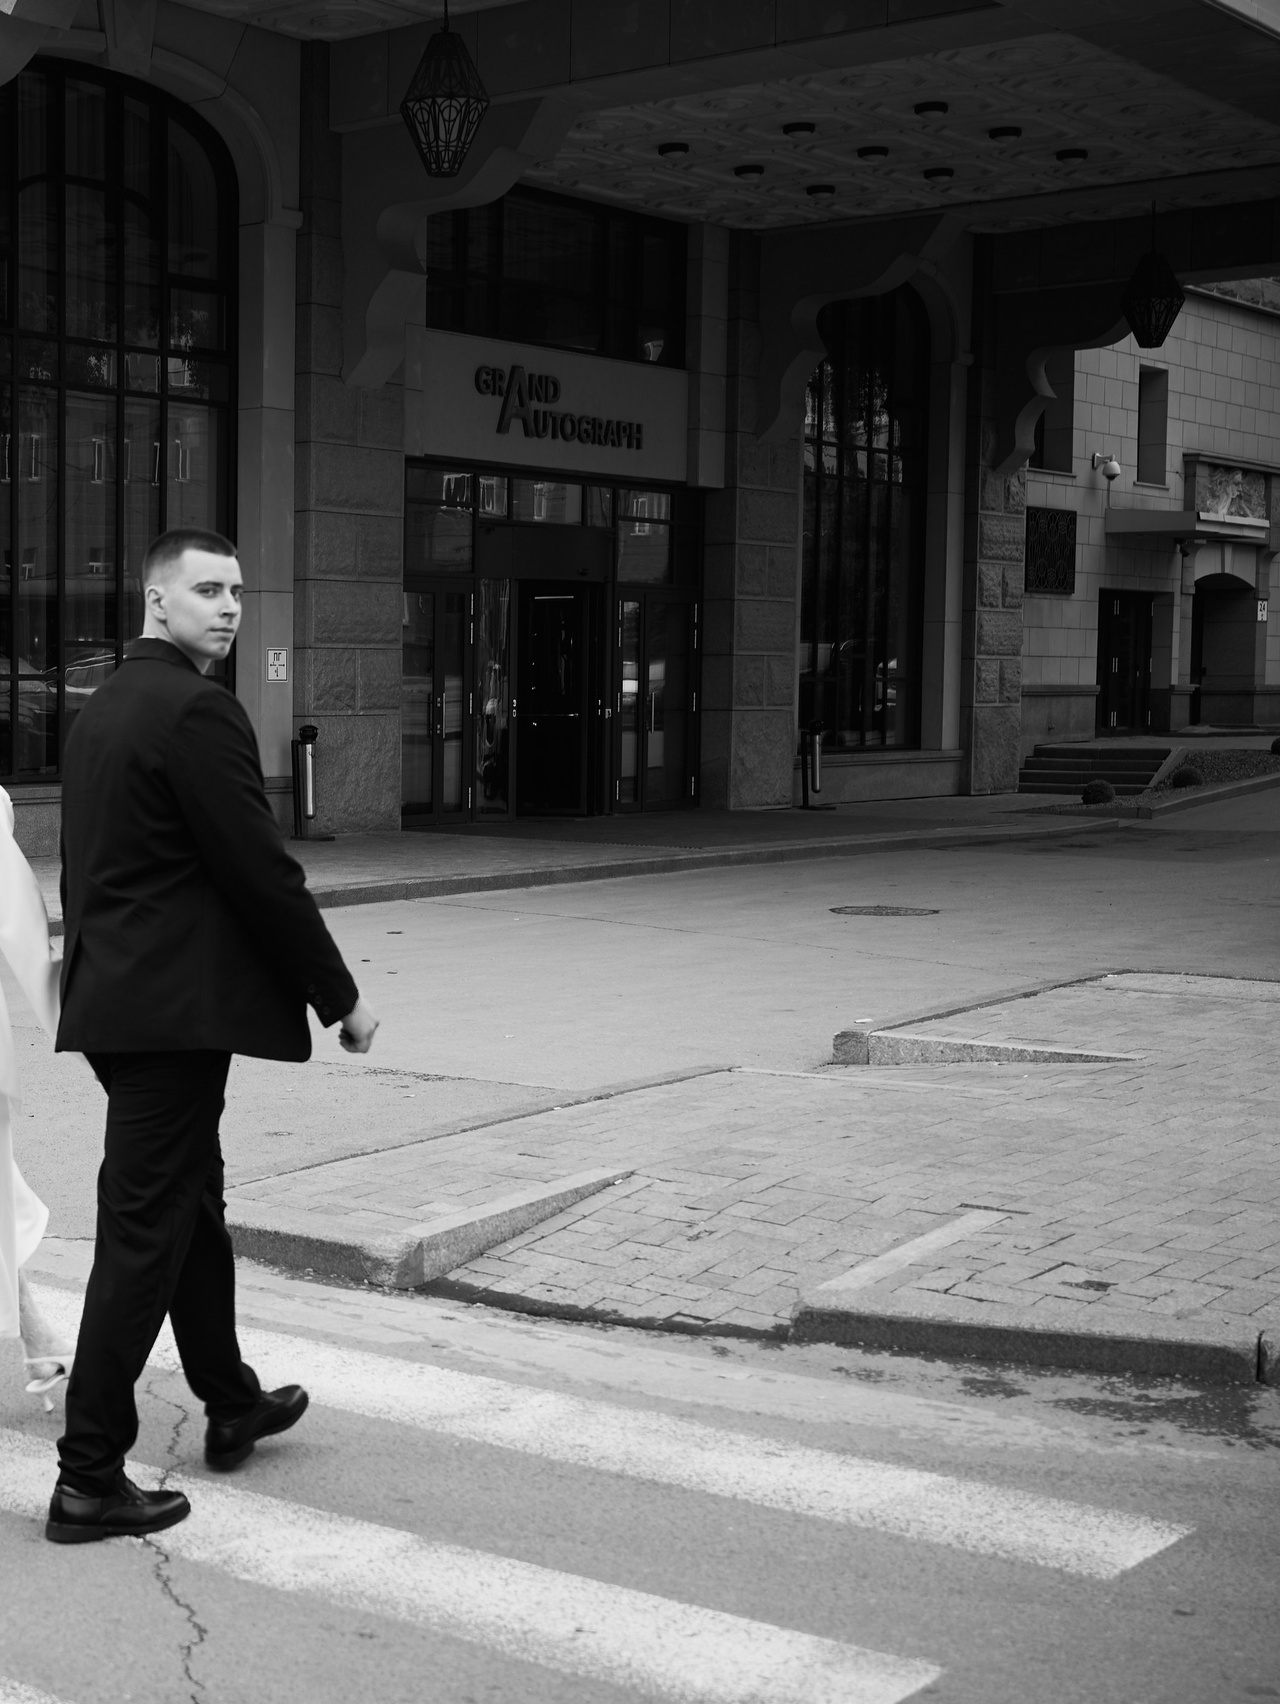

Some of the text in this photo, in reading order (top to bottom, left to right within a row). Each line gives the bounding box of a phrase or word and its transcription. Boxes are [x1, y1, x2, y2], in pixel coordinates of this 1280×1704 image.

[475, 365, 561, 437] GRAND
[496, 365, 643, 449] AUTOGRAPH
[273, 652, 282, 661] ПГ
